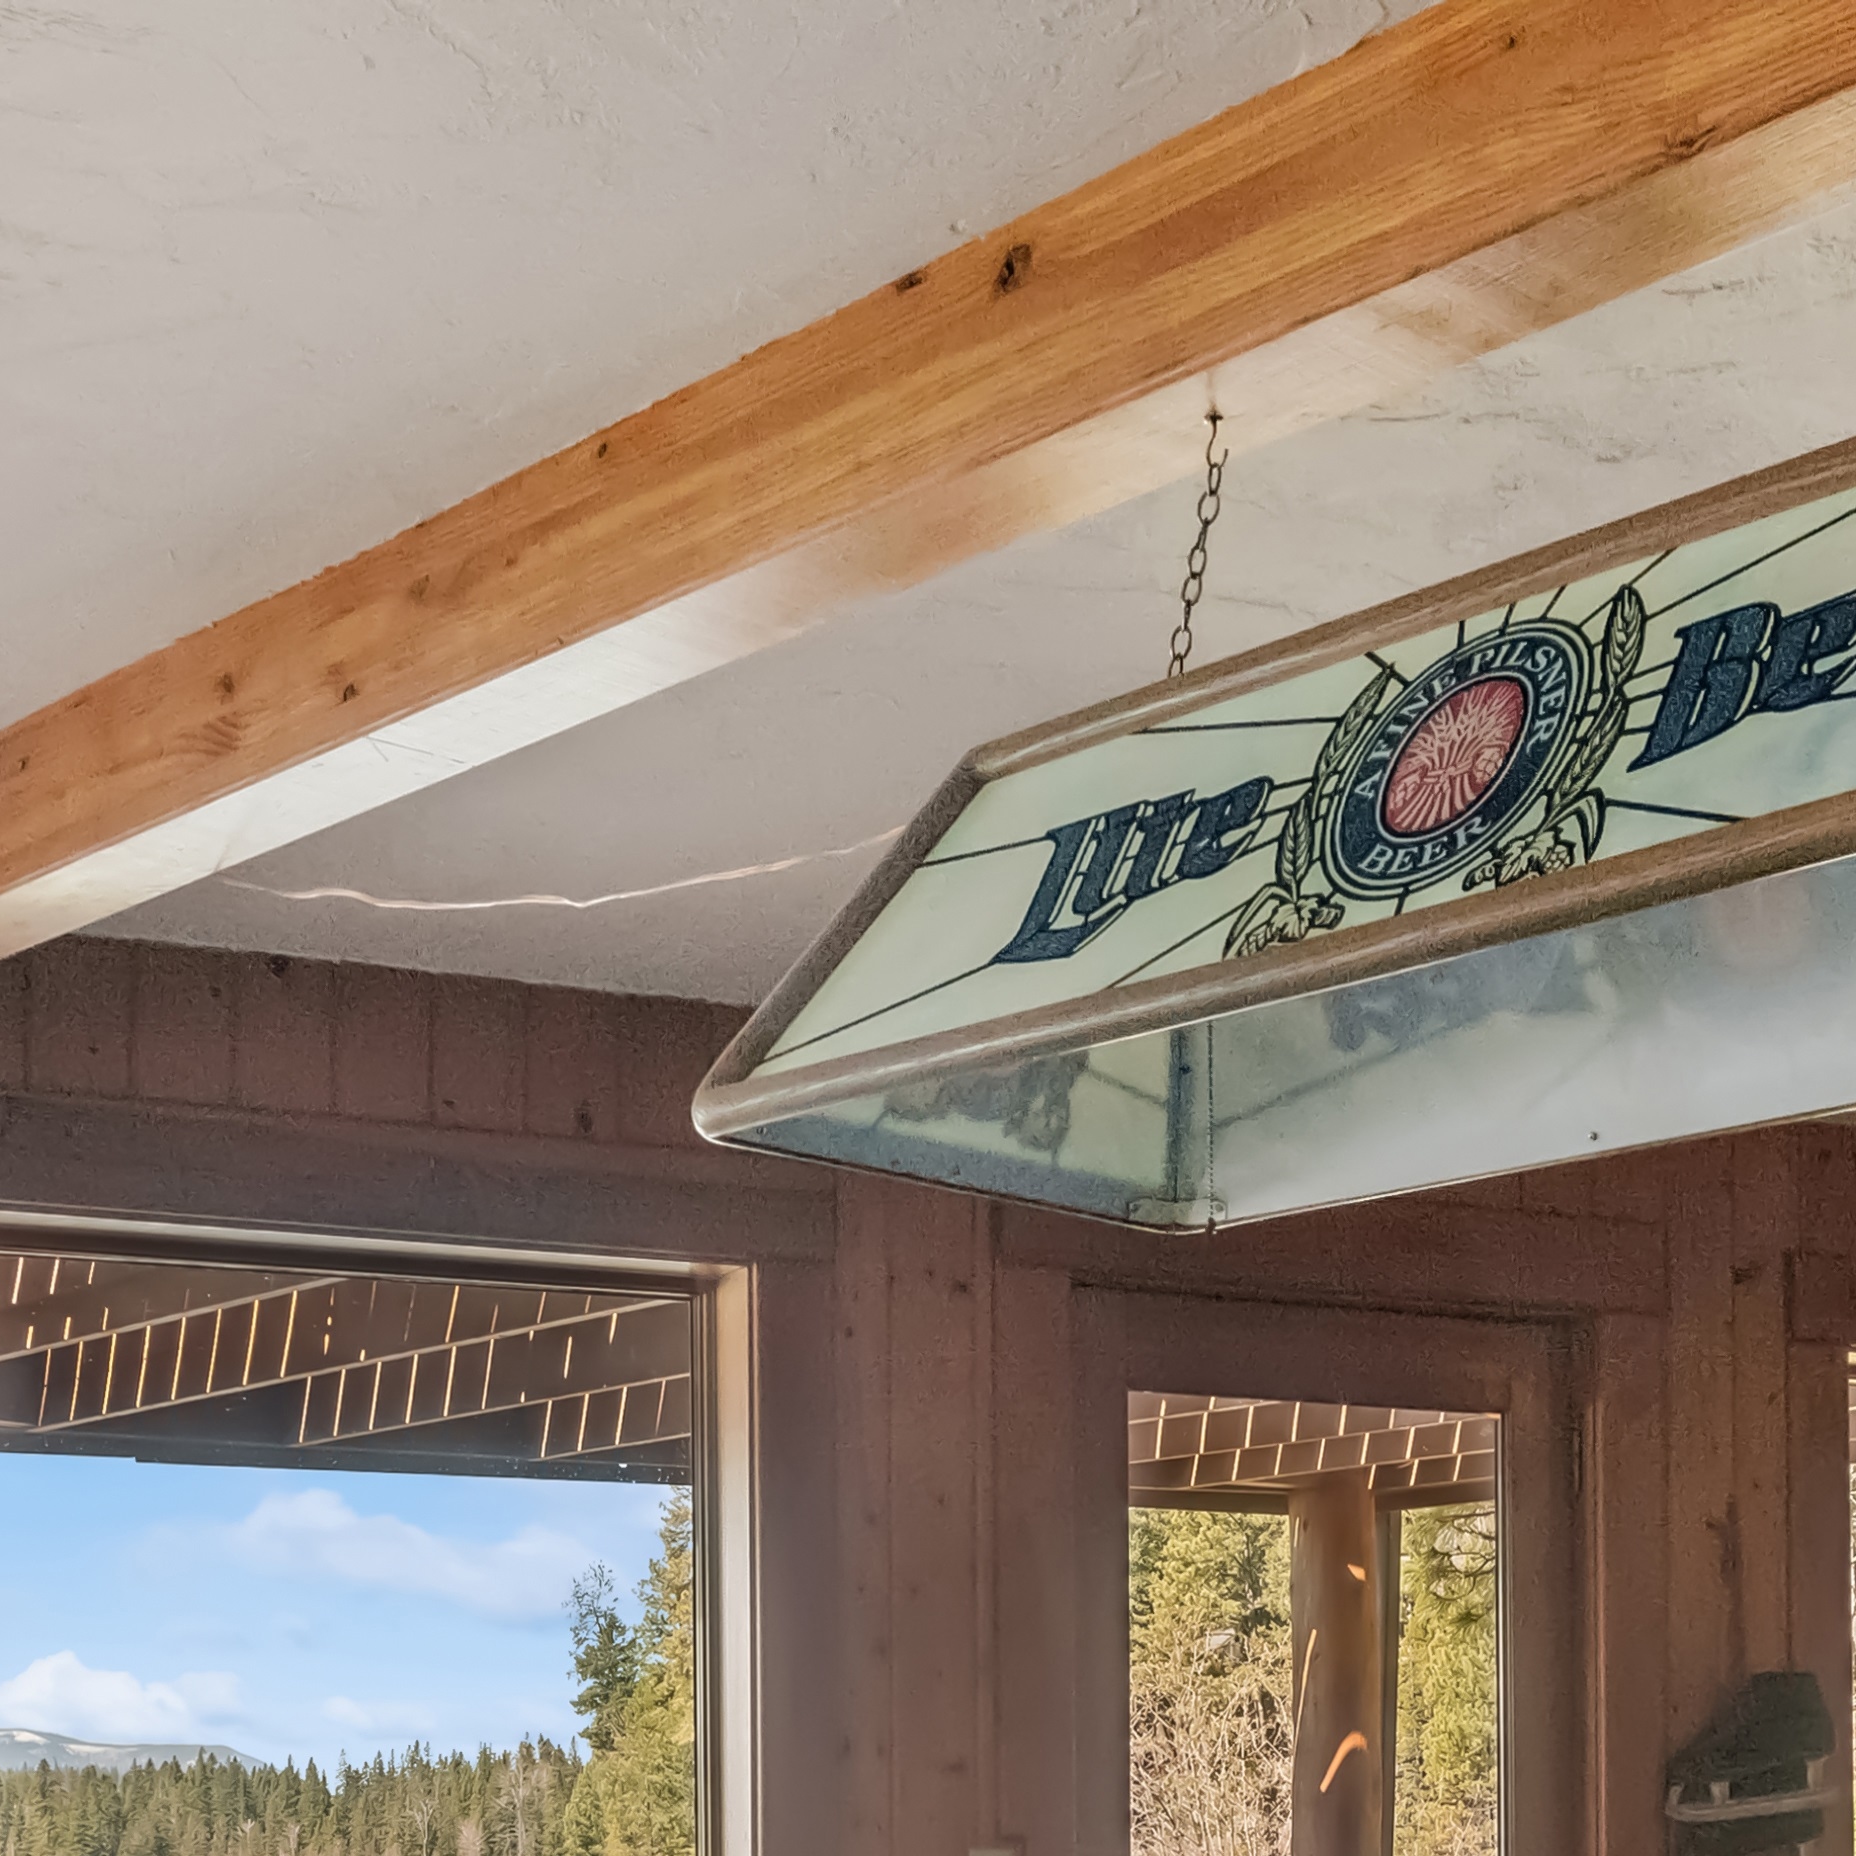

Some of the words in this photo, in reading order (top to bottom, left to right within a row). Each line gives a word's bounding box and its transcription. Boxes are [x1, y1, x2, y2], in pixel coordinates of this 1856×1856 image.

[1367, 667, 1456, 763] FINE
[1470, 641, 1567, 755] PILSNER
[1354, 769, 1383, 799] A
[989, 776, 1275, 964] Lite
[1357, 816, 1493, 874] BEER
